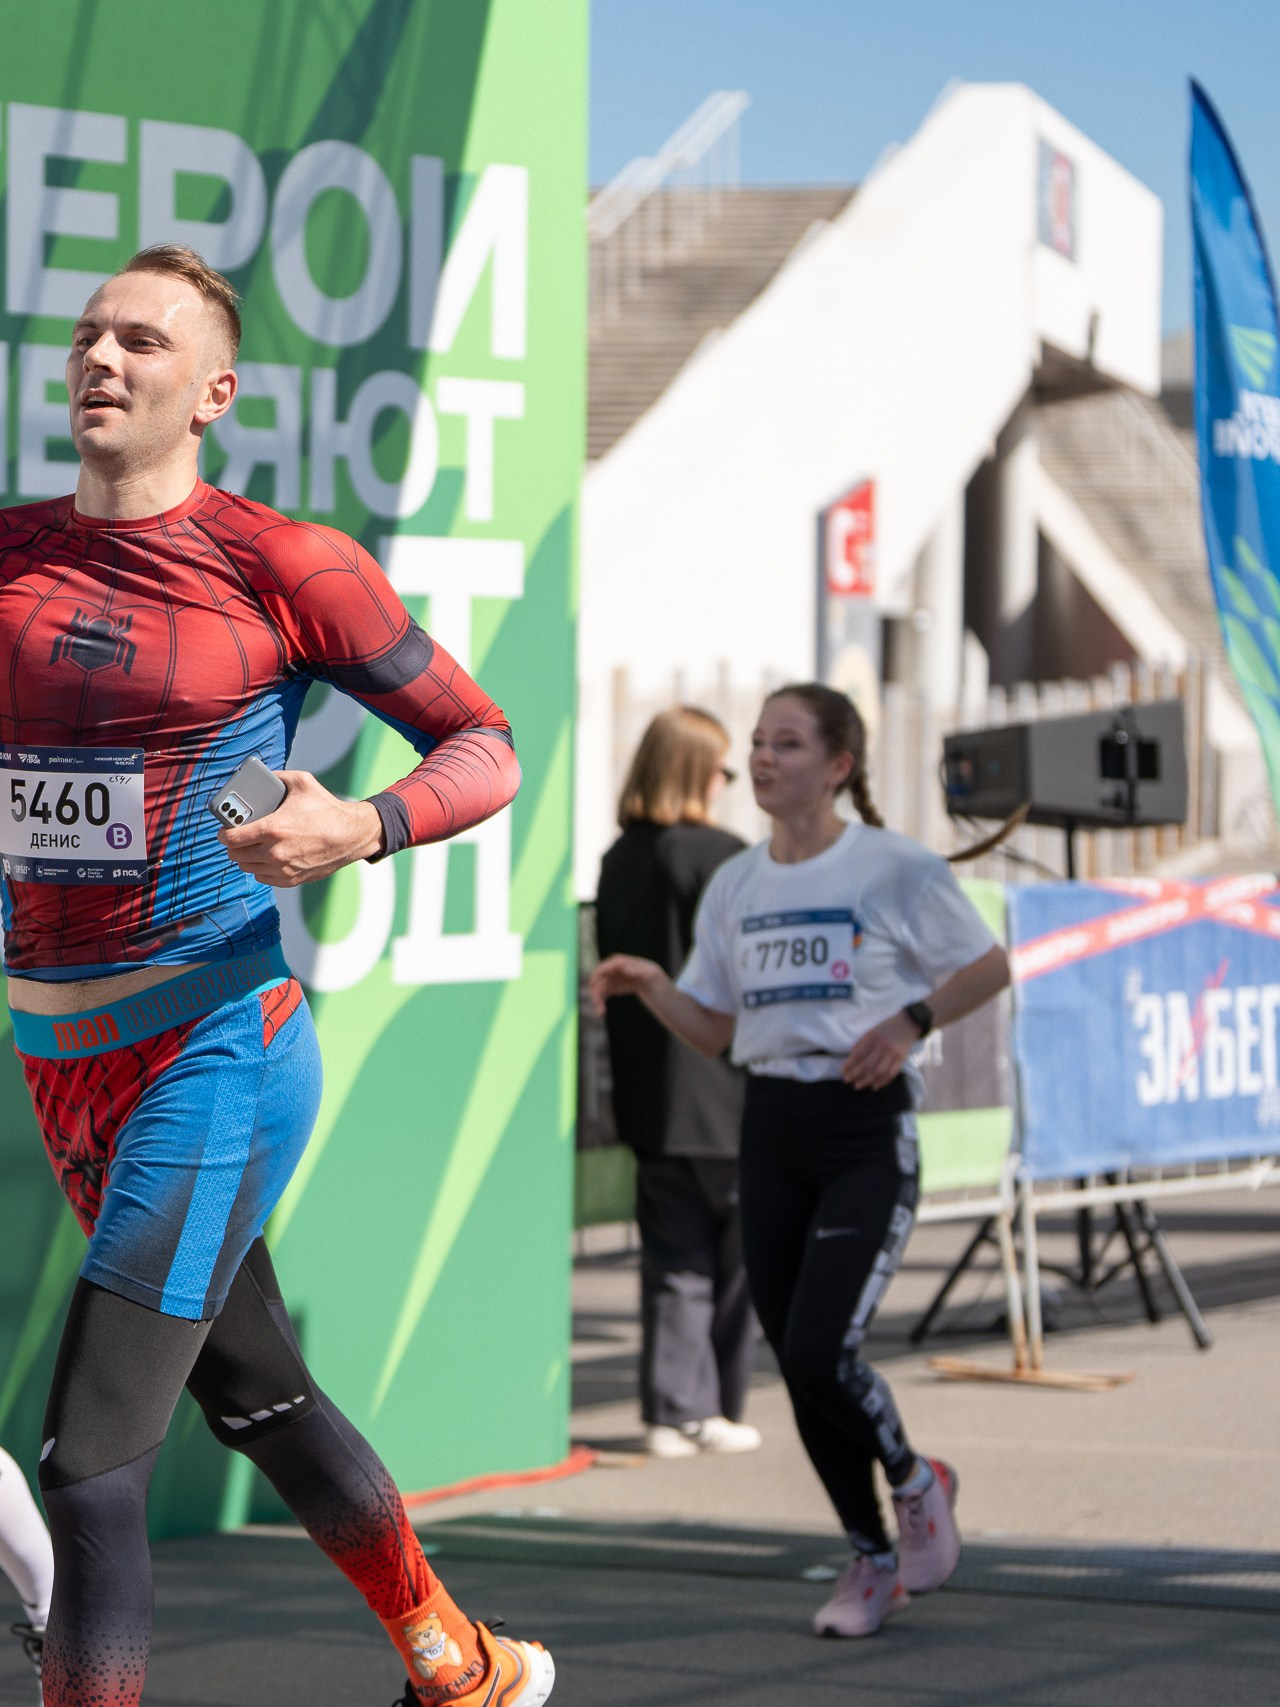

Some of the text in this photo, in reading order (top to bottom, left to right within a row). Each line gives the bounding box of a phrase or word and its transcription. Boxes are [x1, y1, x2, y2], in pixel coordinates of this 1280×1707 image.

[10, 778, 111, 827] 5460
[30, 832, 81, 850] ДЕНИС
[756, 936, 829, 971] 7780
[52, 952, 273, 1051] man UNDERWEAR
